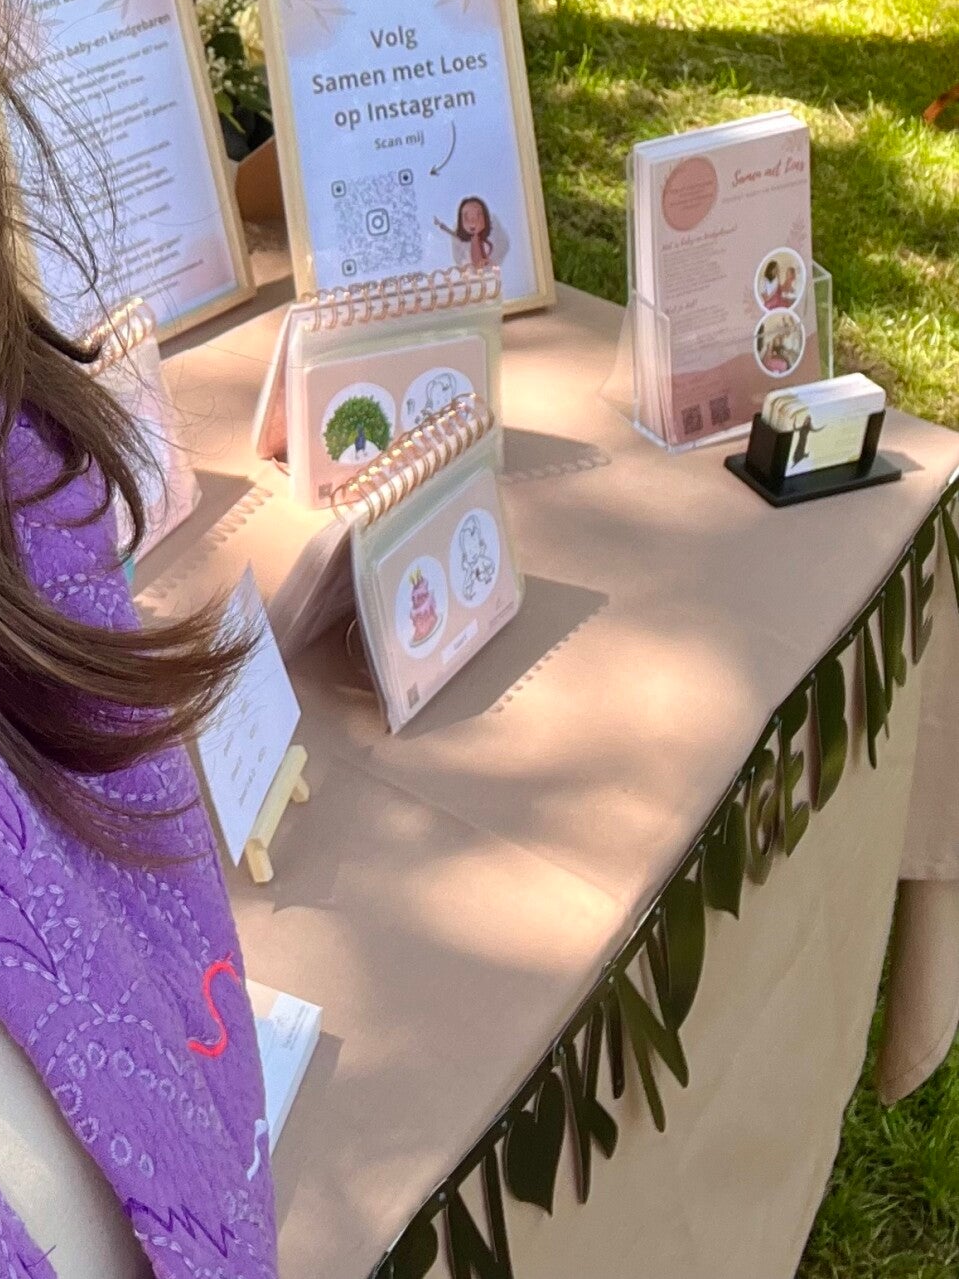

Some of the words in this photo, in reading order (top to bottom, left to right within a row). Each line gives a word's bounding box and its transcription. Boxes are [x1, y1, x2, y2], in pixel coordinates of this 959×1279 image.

[108, 13, 170, 41] kindgebaren
[369, 24, 418, 50] Volg
[312, 67, 386, 95] Samen
[392, 58, 434, 85] met
[440, 51, 488, 76] Loes
[335, 107, 361, 130] op
[367, 88, 476, 121] Instagram
[374, 134, 403, 150] Scan
[404, 130, 425, 149] mij
